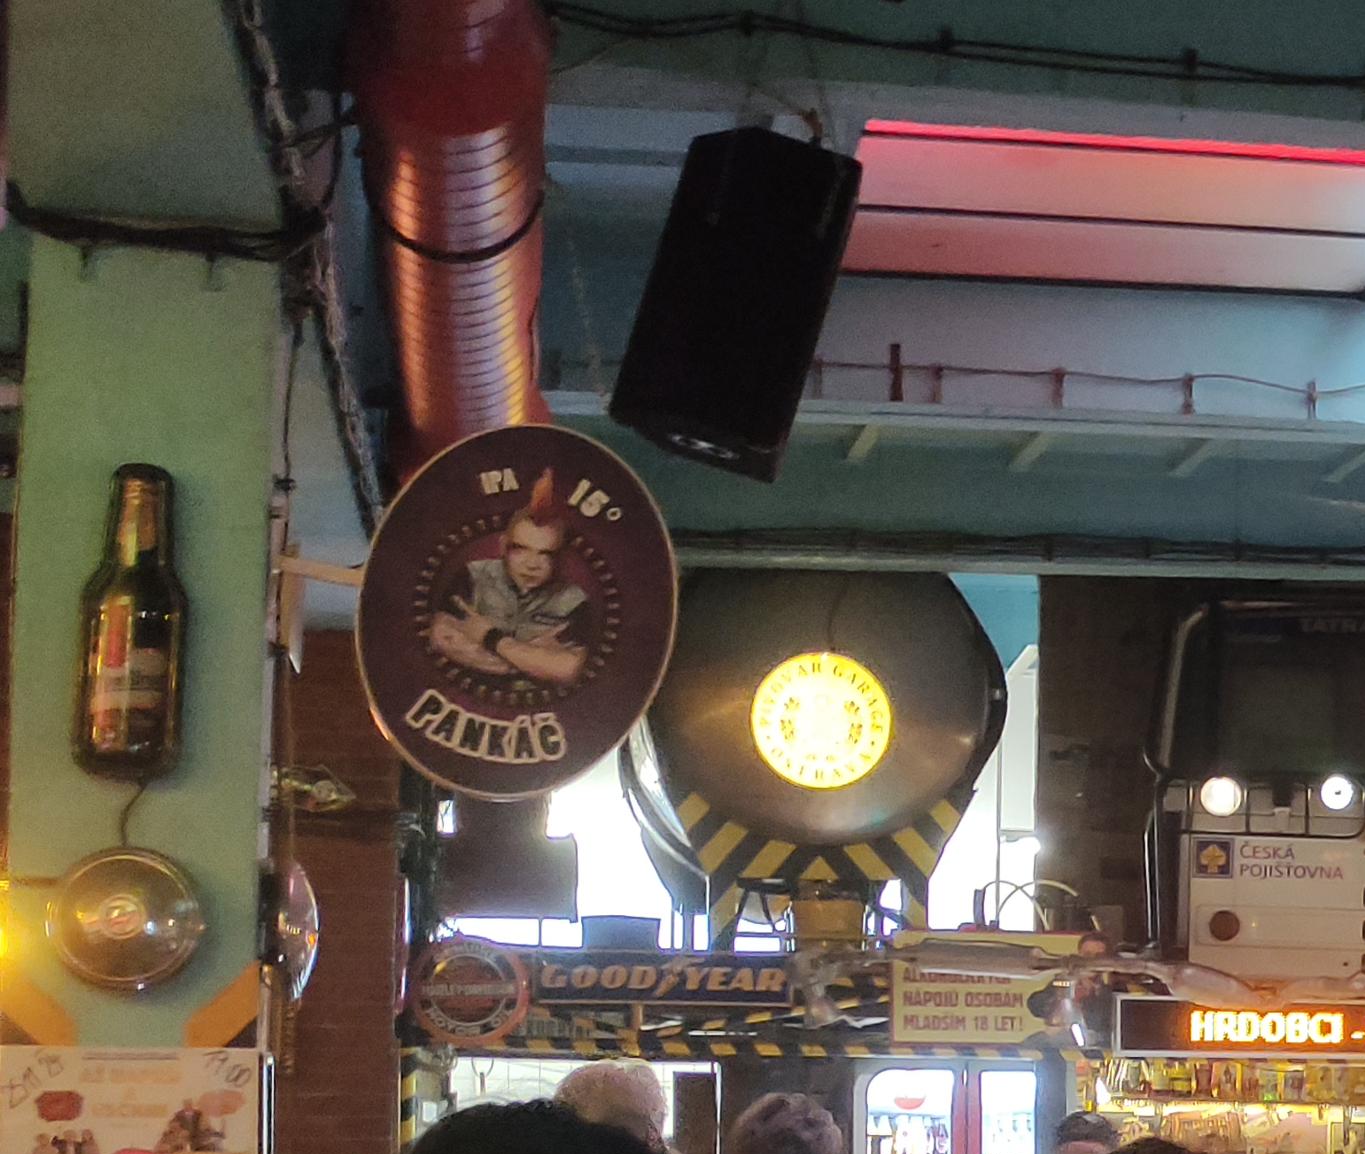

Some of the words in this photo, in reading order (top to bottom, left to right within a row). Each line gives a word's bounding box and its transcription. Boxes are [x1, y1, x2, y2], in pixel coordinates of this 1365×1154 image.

[480, 468, 520, 496] IPA
[1239, 839, 1295, 860] ČESKÁ
[540, 960, 788, 994] GOODYEAR
[974, 1016, 989, 1031] 18
